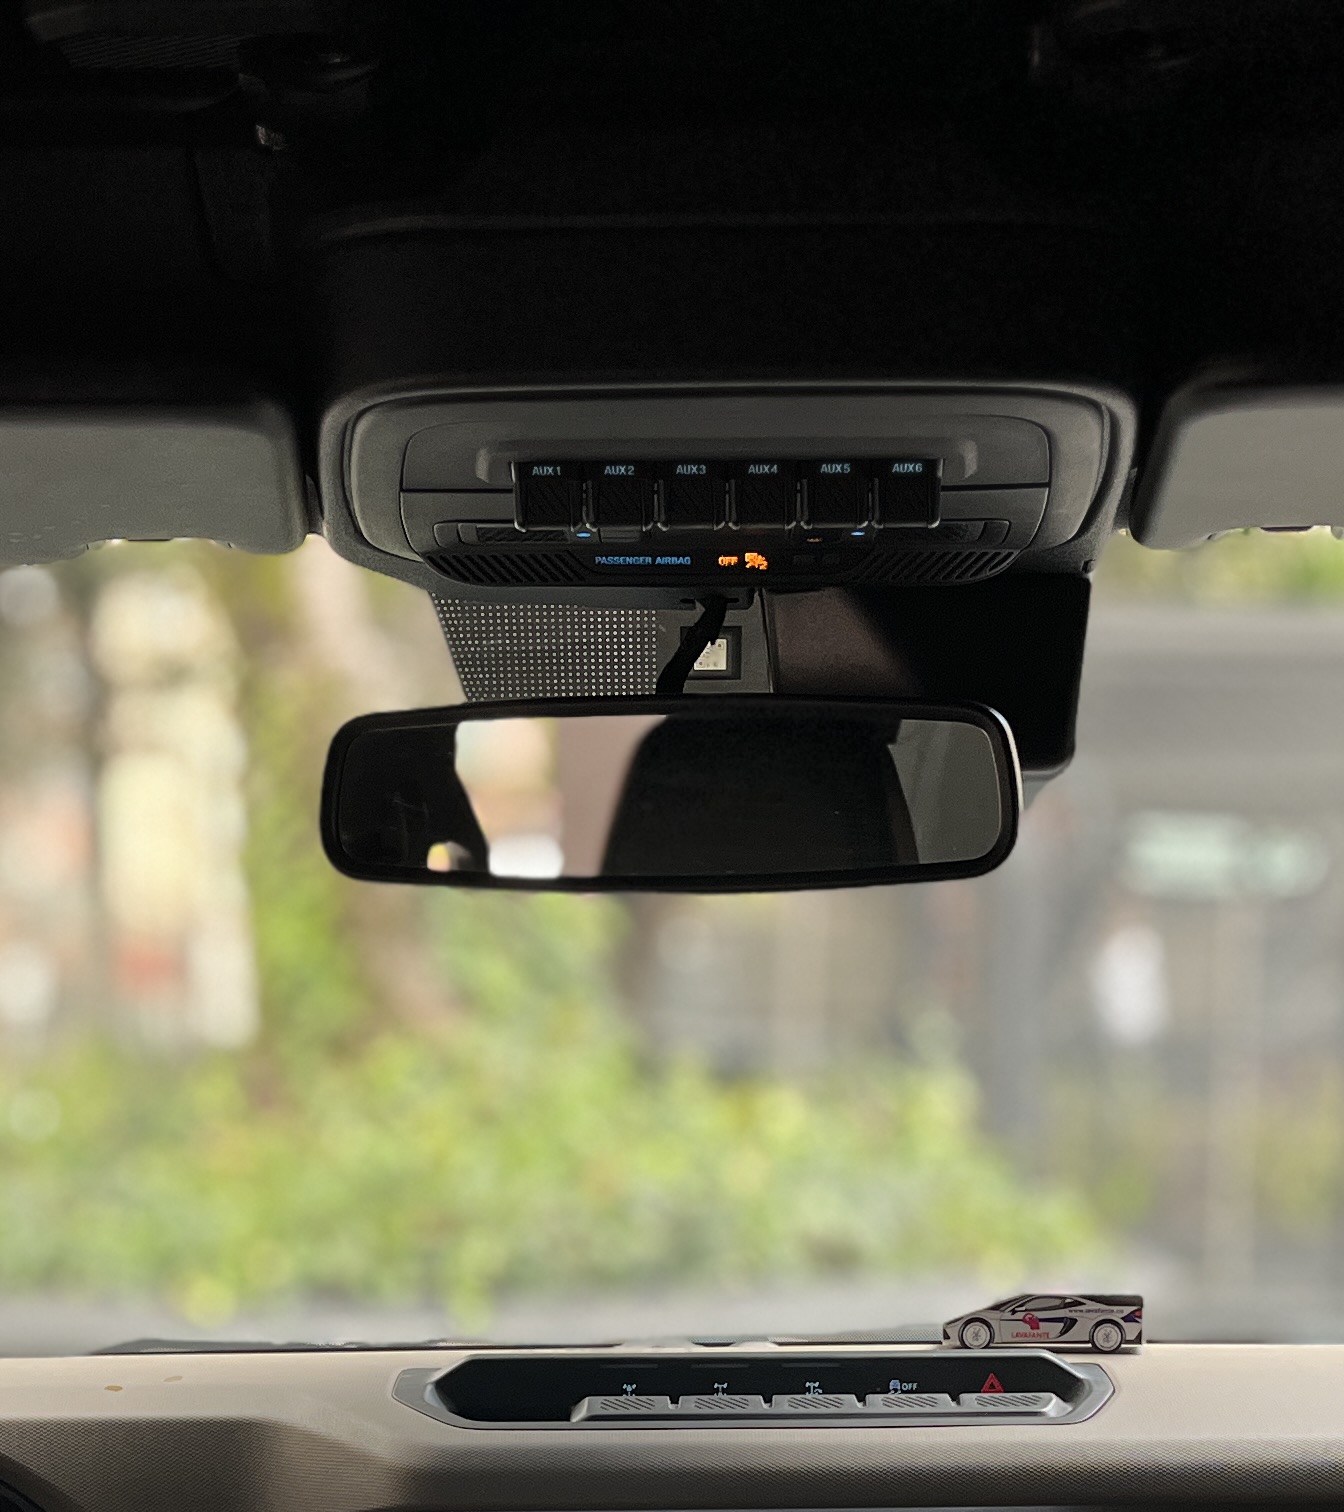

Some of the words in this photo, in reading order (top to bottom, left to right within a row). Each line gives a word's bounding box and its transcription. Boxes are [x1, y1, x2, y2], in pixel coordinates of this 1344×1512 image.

[595, 555, 652, 566] PASSENGER
[655, 555, 692, 566] AIRBAG
[718, 555, 739, 567] OFF
[901, 1382, 918, 1391] OFF
